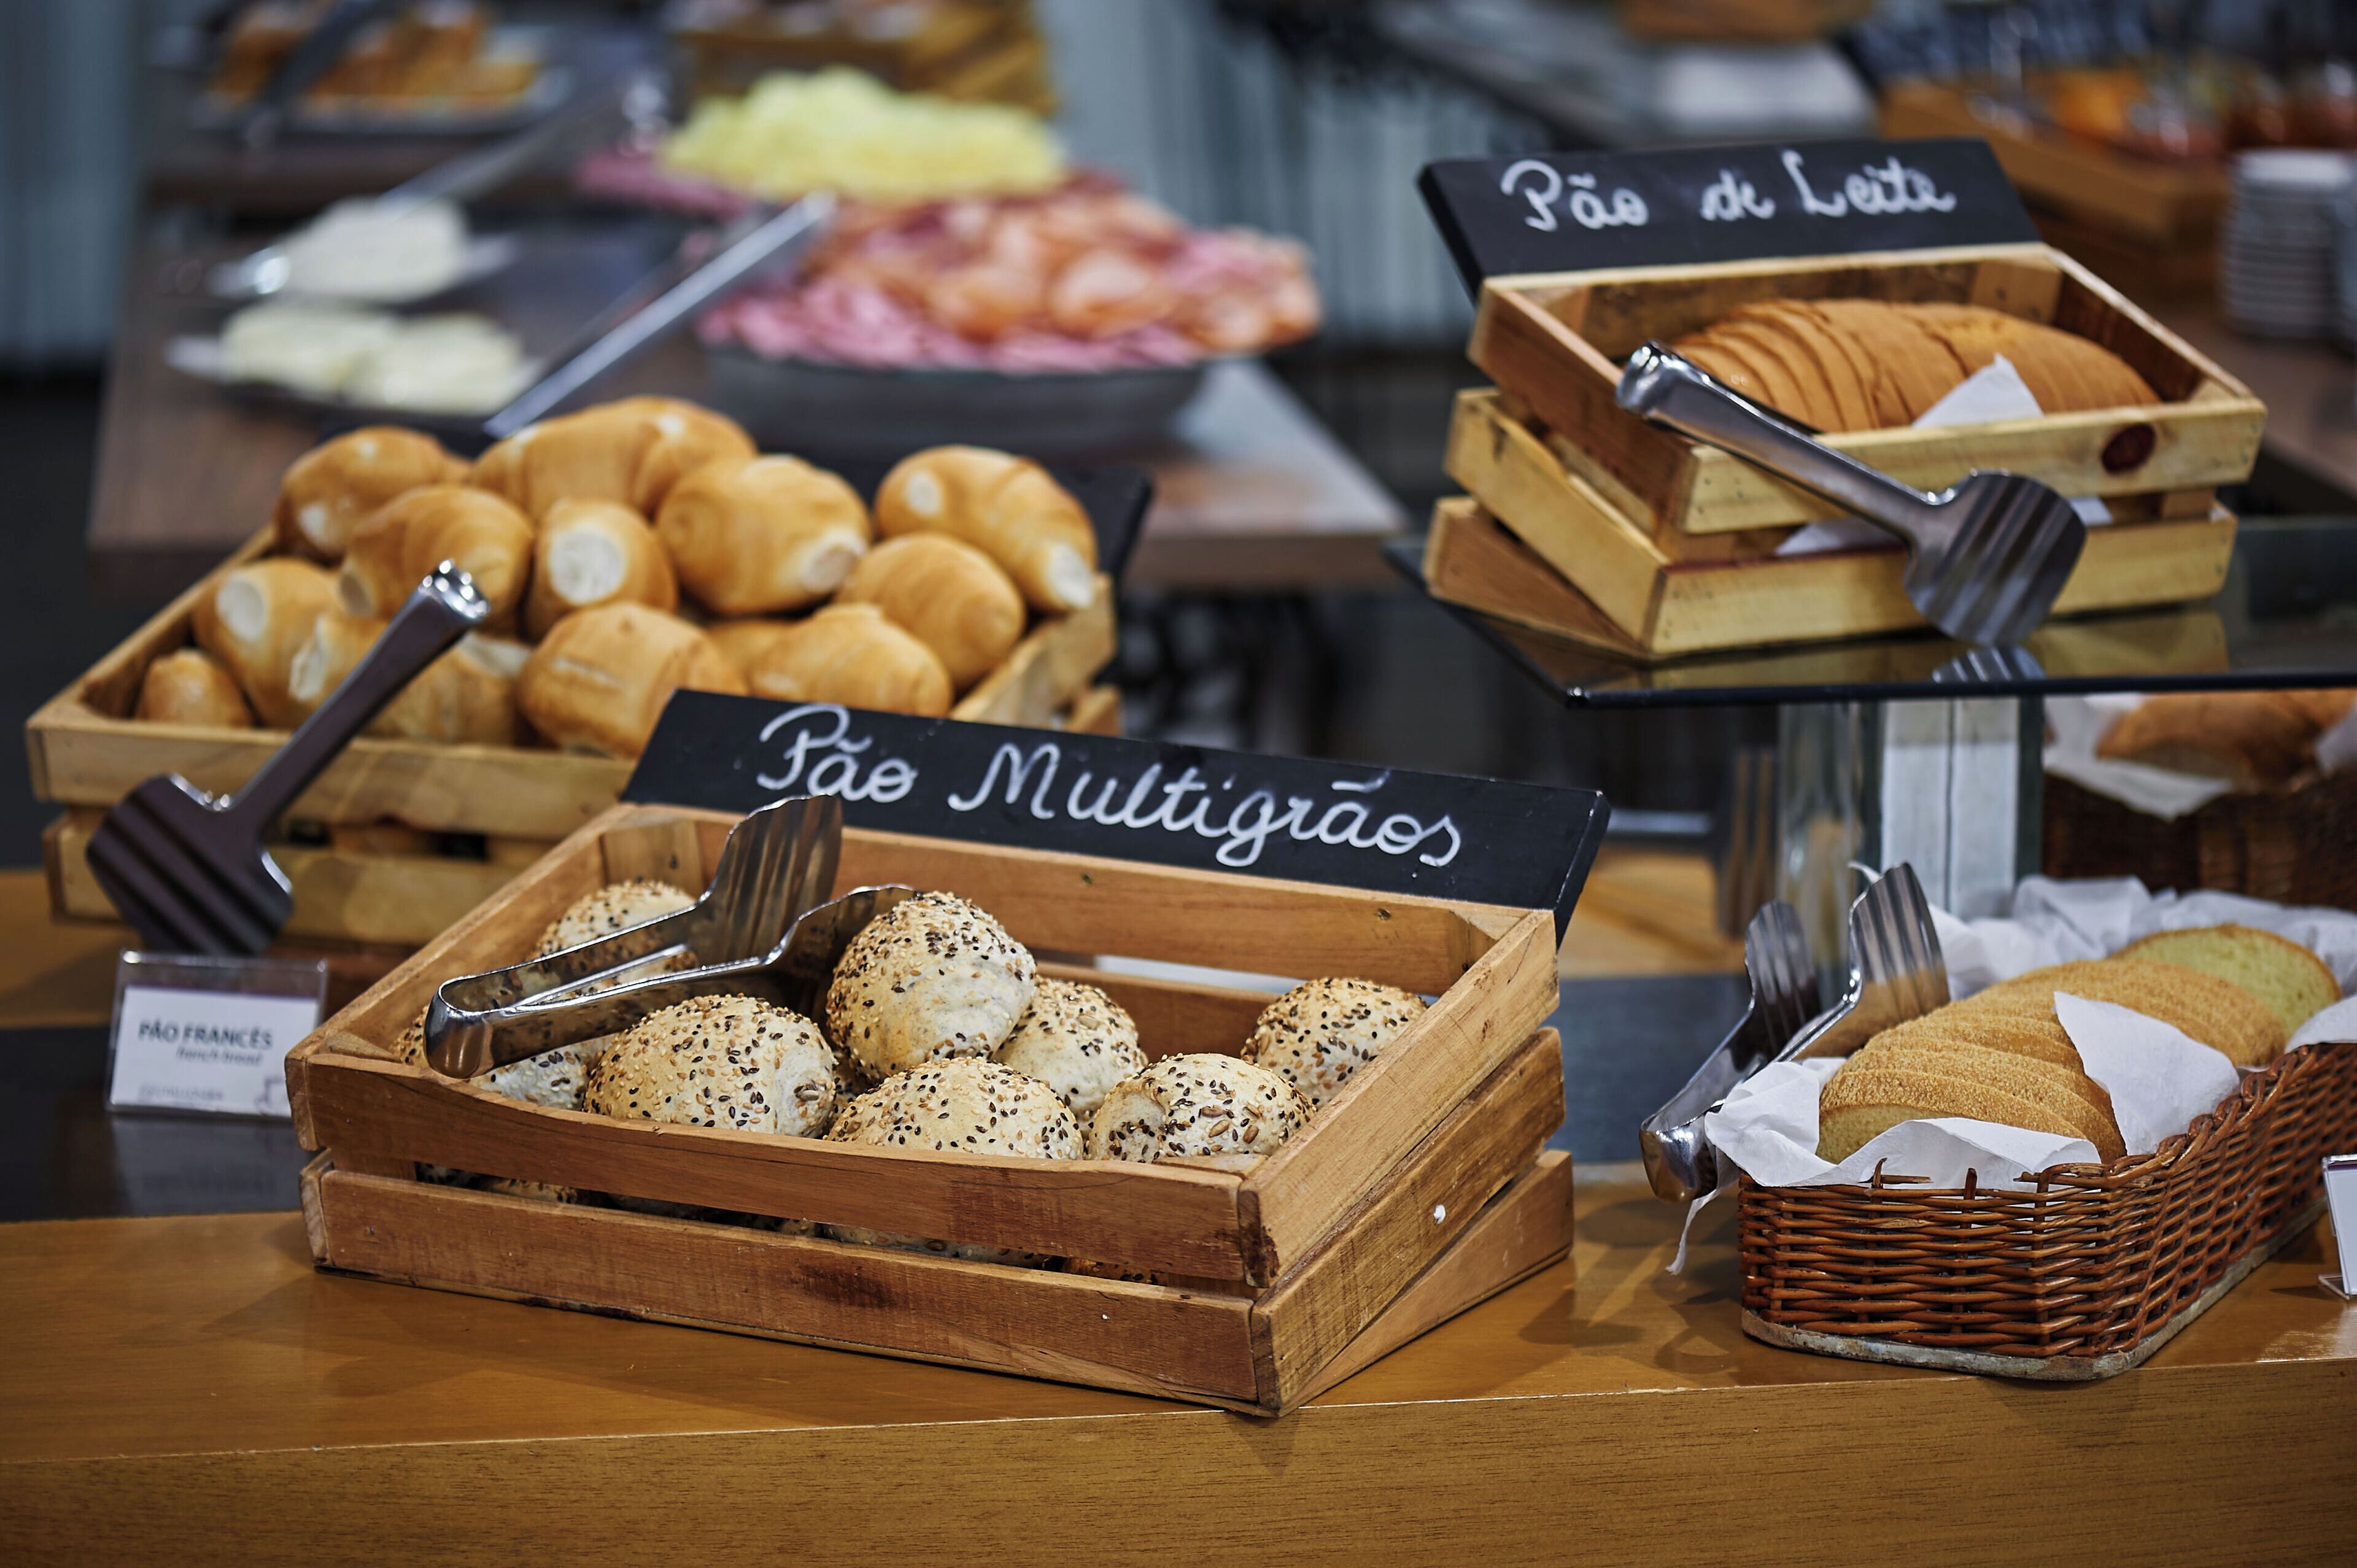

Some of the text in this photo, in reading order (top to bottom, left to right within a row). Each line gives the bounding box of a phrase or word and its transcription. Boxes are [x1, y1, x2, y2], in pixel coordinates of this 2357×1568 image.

[1500, 150, 1957, 231] Pão de Leite
[756, 703, 1461, 868] Pão Multigrãos
[138, 1019, 273, 1050] PÃO FRANCÊS
